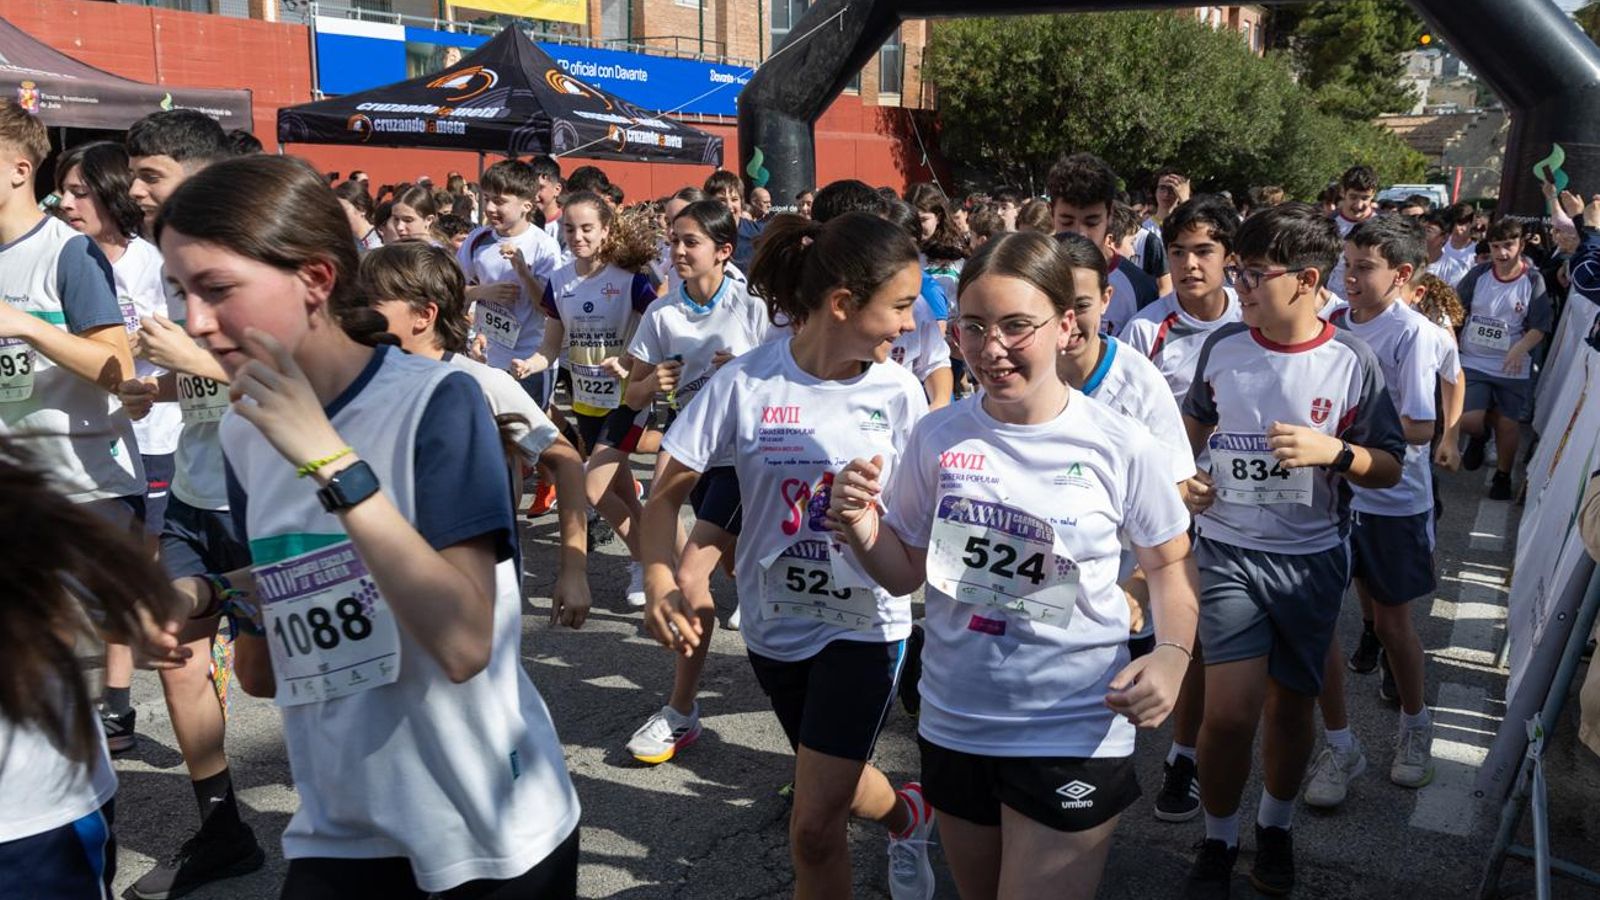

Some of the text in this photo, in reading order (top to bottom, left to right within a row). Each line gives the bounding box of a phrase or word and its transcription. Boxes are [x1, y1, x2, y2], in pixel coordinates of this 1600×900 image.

[570, 61, 597, 78] oficial
[598, 65, 614, 78] con
[615, 65, 648, 82] Davante
[485, 312, 510, 333] 954
[1478, 326, 1503, 340] 858
[179, 376, 218, 400] 1089
[577, 378, 615, 395] 1222
[761, 406, 801, 424] XXVII
[939, 451, 986, 471] XXVII
[1231, 458, 1291, 482] 834
[962, 536, 1046, 585] 524
[273, 597, 373, 659] 1088
[1061, 798, 1094, 809] umbro
